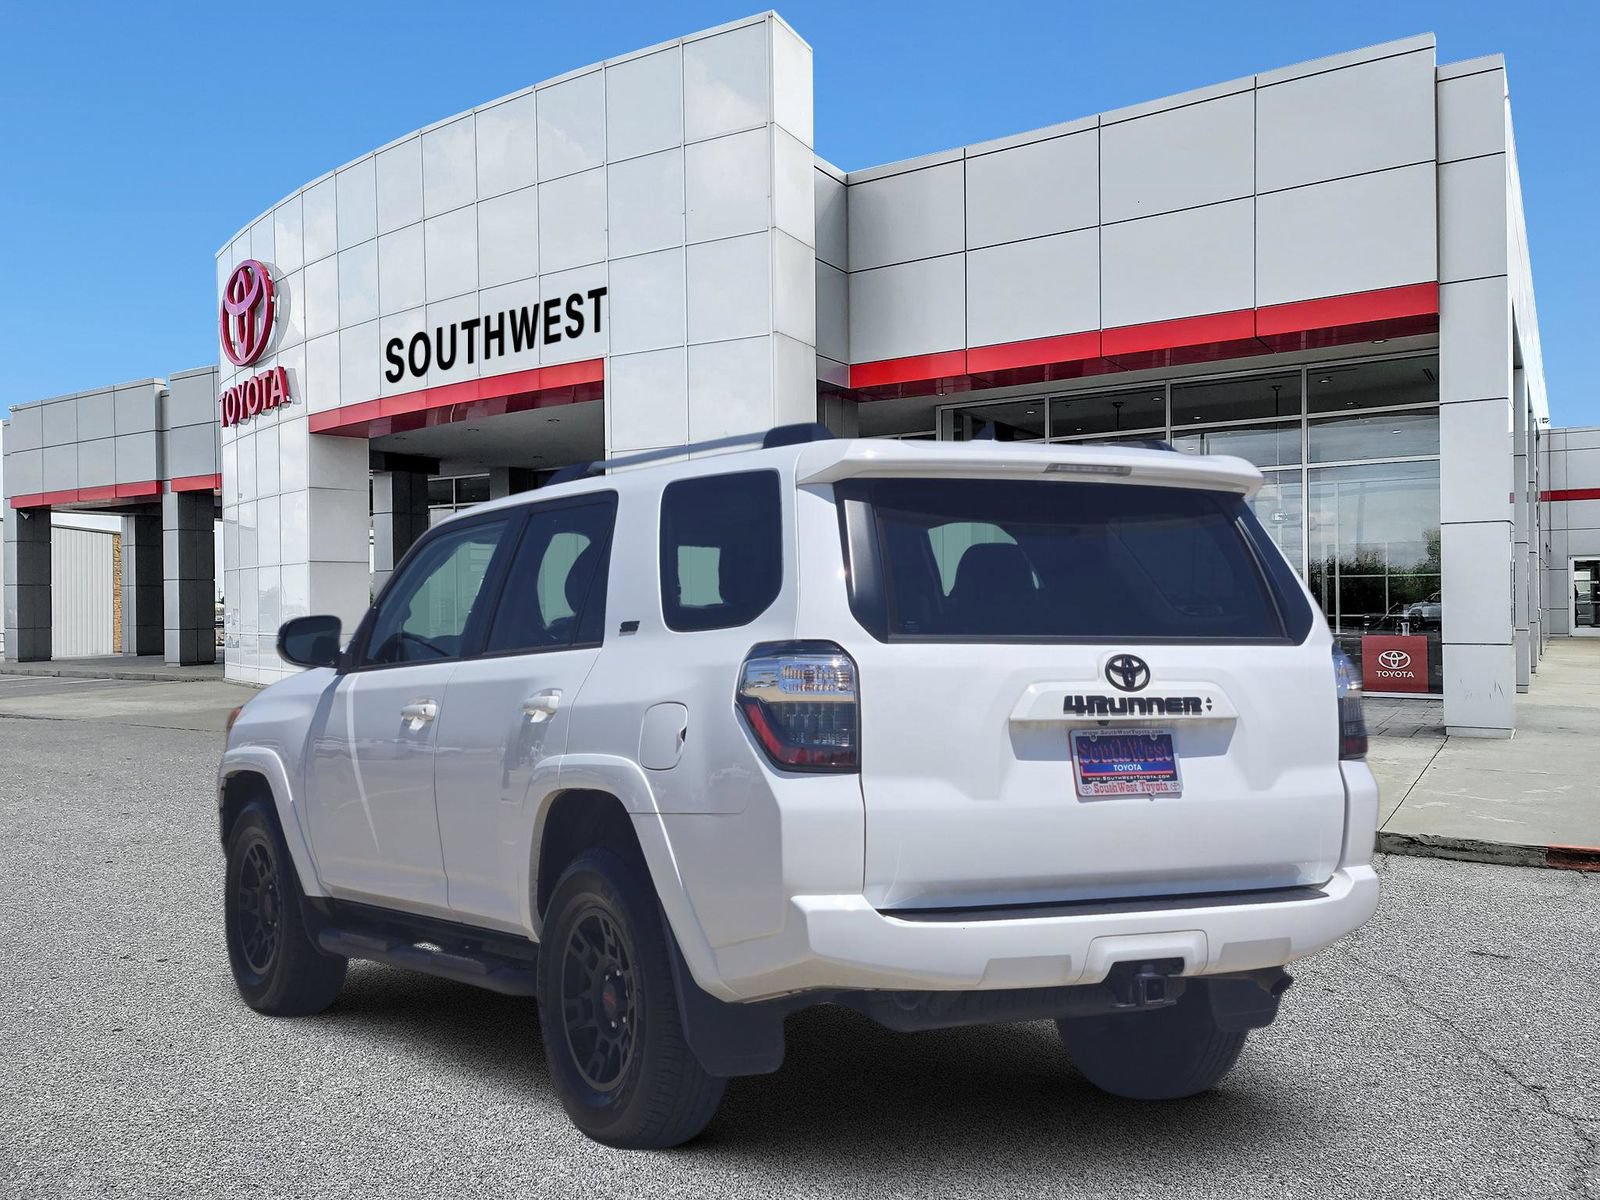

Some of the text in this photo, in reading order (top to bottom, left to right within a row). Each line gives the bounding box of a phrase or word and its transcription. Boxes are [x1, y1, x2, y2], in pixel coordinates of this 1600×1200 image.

[385, 286, 608, 384] SOUTHWEST
[218, 365, 291, 428] TOYOTA
[1376, 670, 1415, 678] TOYOTA
[1093, 780, 1169, 795] SouthWest Toyota
